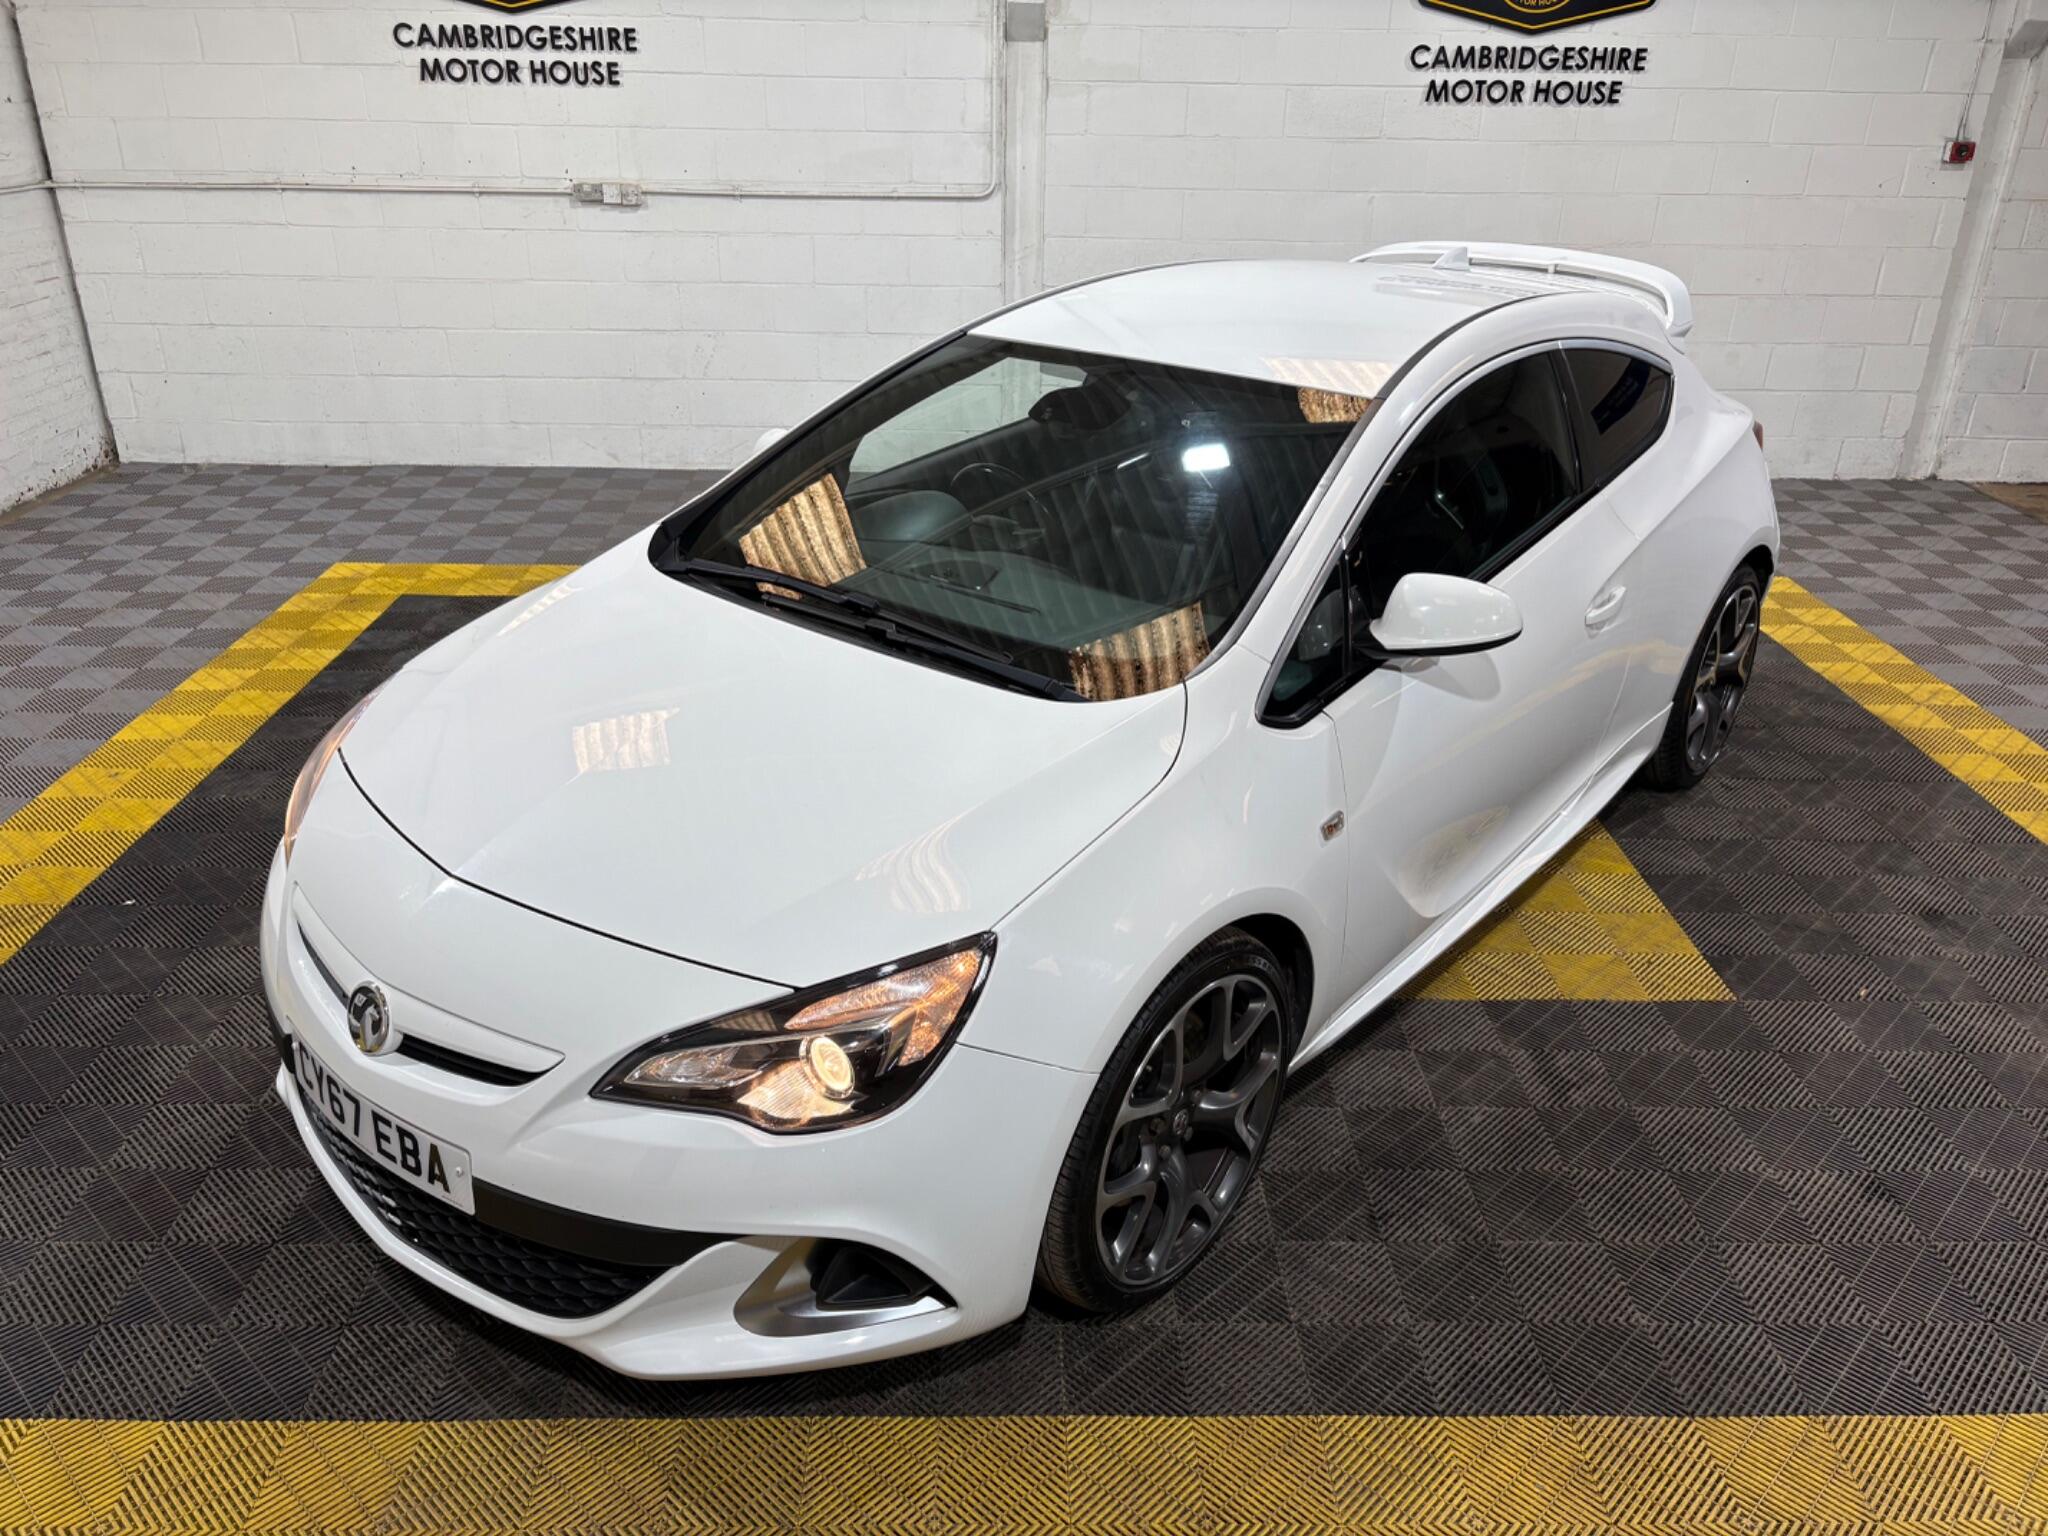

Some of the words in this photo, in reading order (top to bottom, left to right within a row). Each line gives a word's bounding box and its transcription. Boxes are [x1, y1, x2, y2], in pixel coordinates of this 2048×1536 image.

[393, 22, 638, 52] CAMBRIDGESHIRE
[1410, 44, 1648, 71] CAMBRIDGESHIRE
[420, 58, 520, 84] MOTOR
[529, 60, 620, 86] HOUSE
[1425, 79, 1524, 104] MOTOR
[1533, 80, 1622, 105] HOUSE
[298, 1043, 361, 1138] CY67
[371, 1110, 451, 1194] EBA
